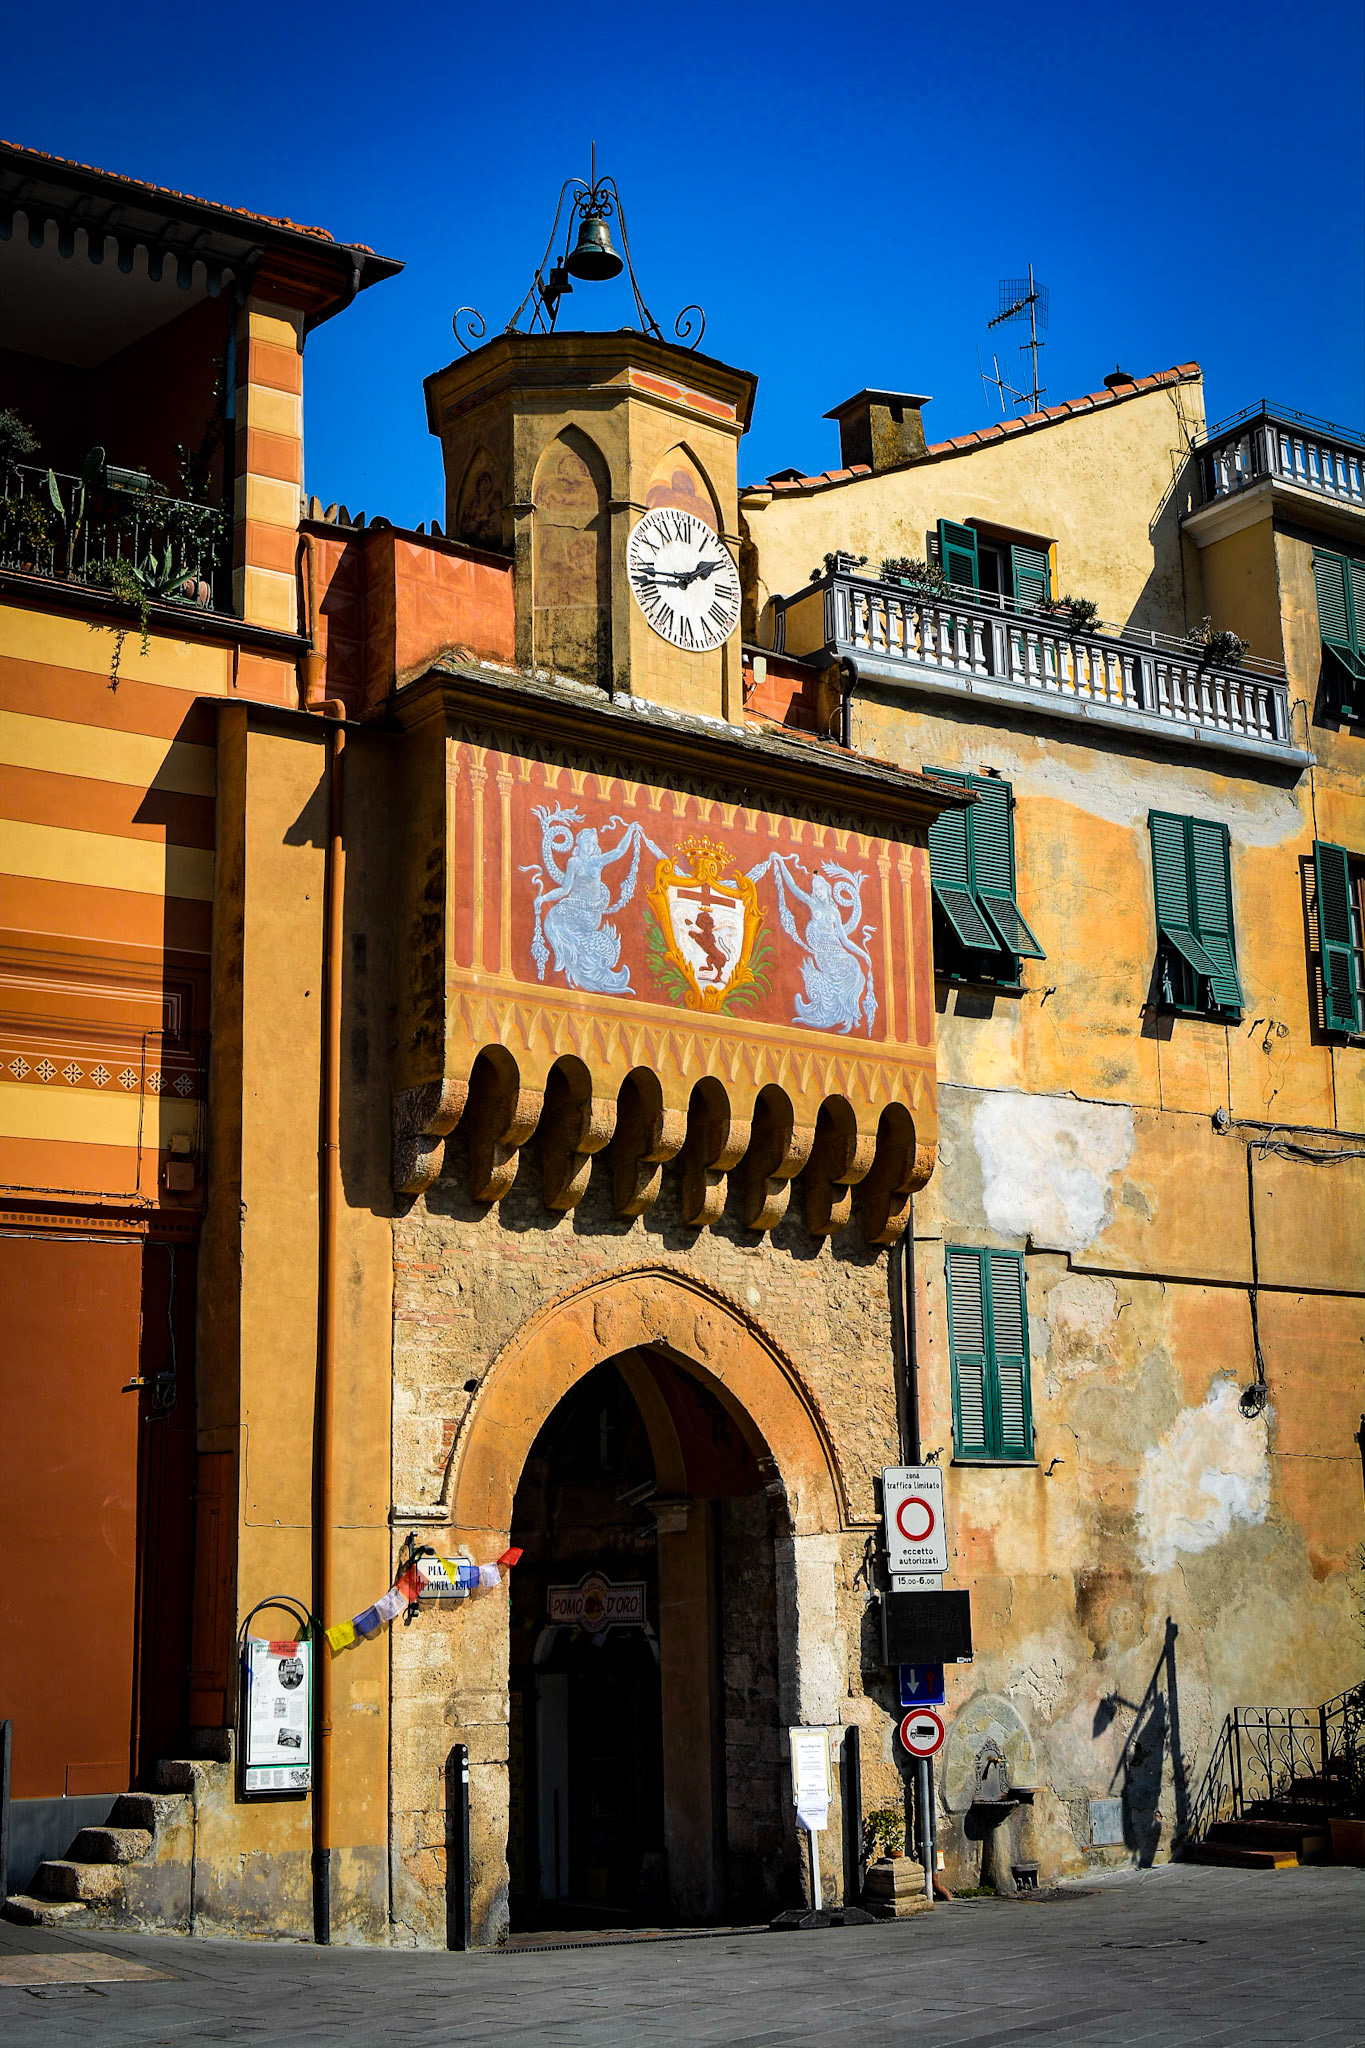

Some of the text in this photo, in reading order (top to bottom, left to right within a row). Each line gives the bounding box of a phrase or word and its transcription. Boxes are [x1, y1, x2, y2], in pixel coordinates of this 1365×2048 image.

[653, 520, 672, 546] XI
[673, 519, 691, 544] XII
[641, 534, 660, 555] X
[698, 537, 708, 552] I
[715, 584, 731, 600] III
[656, 603, 674, 630] VII
[708, 601, 729, 627] IIII
[680, 616, 694, 639] VI
[700, 616, 714, 640] V
[899, 1556, 939, 1565] autorizzati
[902, 1547, 934, 1555] eccetto
[428, 1565, 461, 1575] PIAZA
[427, 1581, 449, 1591] PORTA
[554, 1598, 583, 1615] POMO
